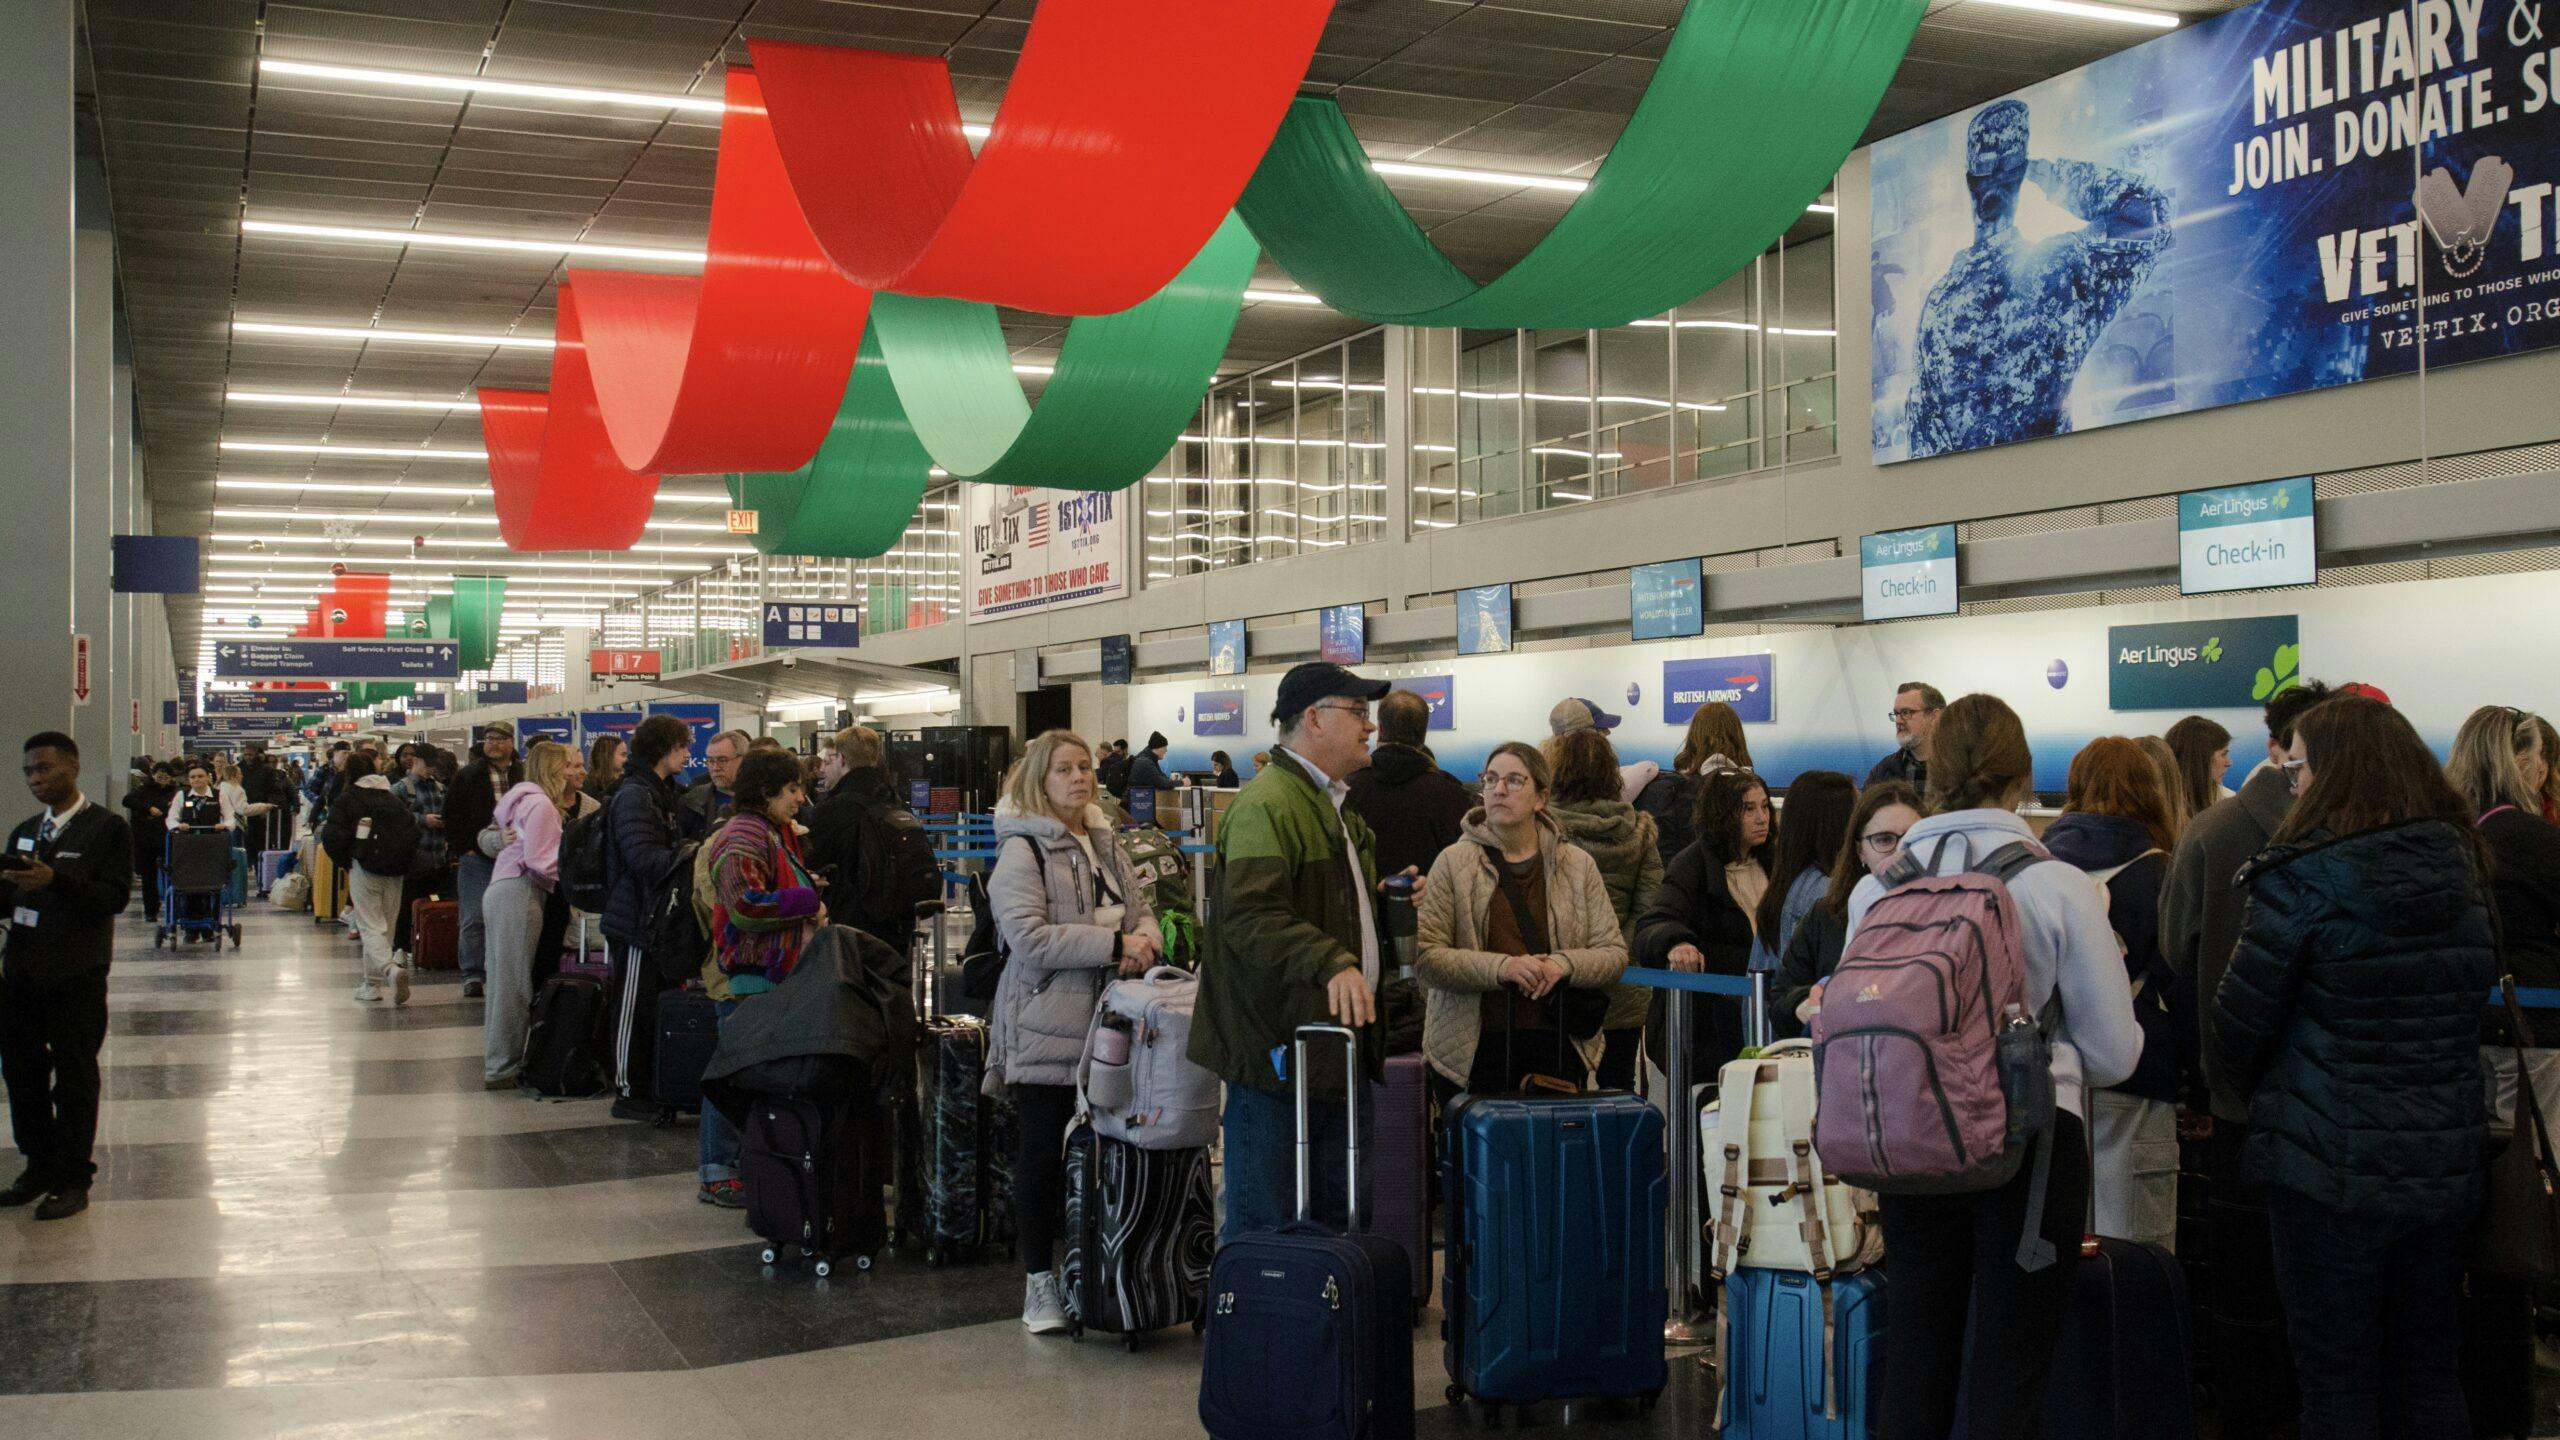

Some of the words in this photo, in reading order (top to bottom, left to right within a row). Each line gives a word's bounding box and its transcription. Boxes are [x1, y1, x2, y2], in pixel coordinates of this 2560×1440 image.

[2253, 0, 2483, 127] MILITARY
[2229, 123, 2322, 196] JOIN.
[2335, 67, 2509, 167] DONATE.
[2317, 219, 2420, 304] VET
[2509, 182, 2560, 262] T
[2341, 308, 2370, 324] GIVE
[2374, 292, 2451, 318] SOMETING
[2456, 287, 2473, 300] TO
[2478, 276, 2522, 295] THOSE
[2200, 502, 2222, 517] Aer
[2224, 496, 2268, 517] Lingus
[730, 511, 754, 528] EXIT
[974, 524, 990, 554] VET
[1002, 515, 1020, 545] TIX
[1876, 544, 1892, 556] Aer
[1893, 539, 1925, 557] Lingus
[2206, 538, 2286, 566] Check-in
[978, 588, 992, 606] GIVE
[994, 579, 1032, 604] SOMETHING
[1033, 578, 1043, 595] TO
[1044, 570, 1067, 593] THOSE
[1069, 567, 1087, 587] WHO
[1089, 561, 1110, 583] GAVE
[1880, 575, 1937, 598] Check-in
[766, 605, 782, 622] A
[632, 655, 642, 668] 7
[2118, 647, 2146, 665] Aer
[2147, 644, 2198, 668] Lingus
[1673, 690, 1705, 704] BRITISH
[1706, 688, 1742, 703] AIRWAYS
